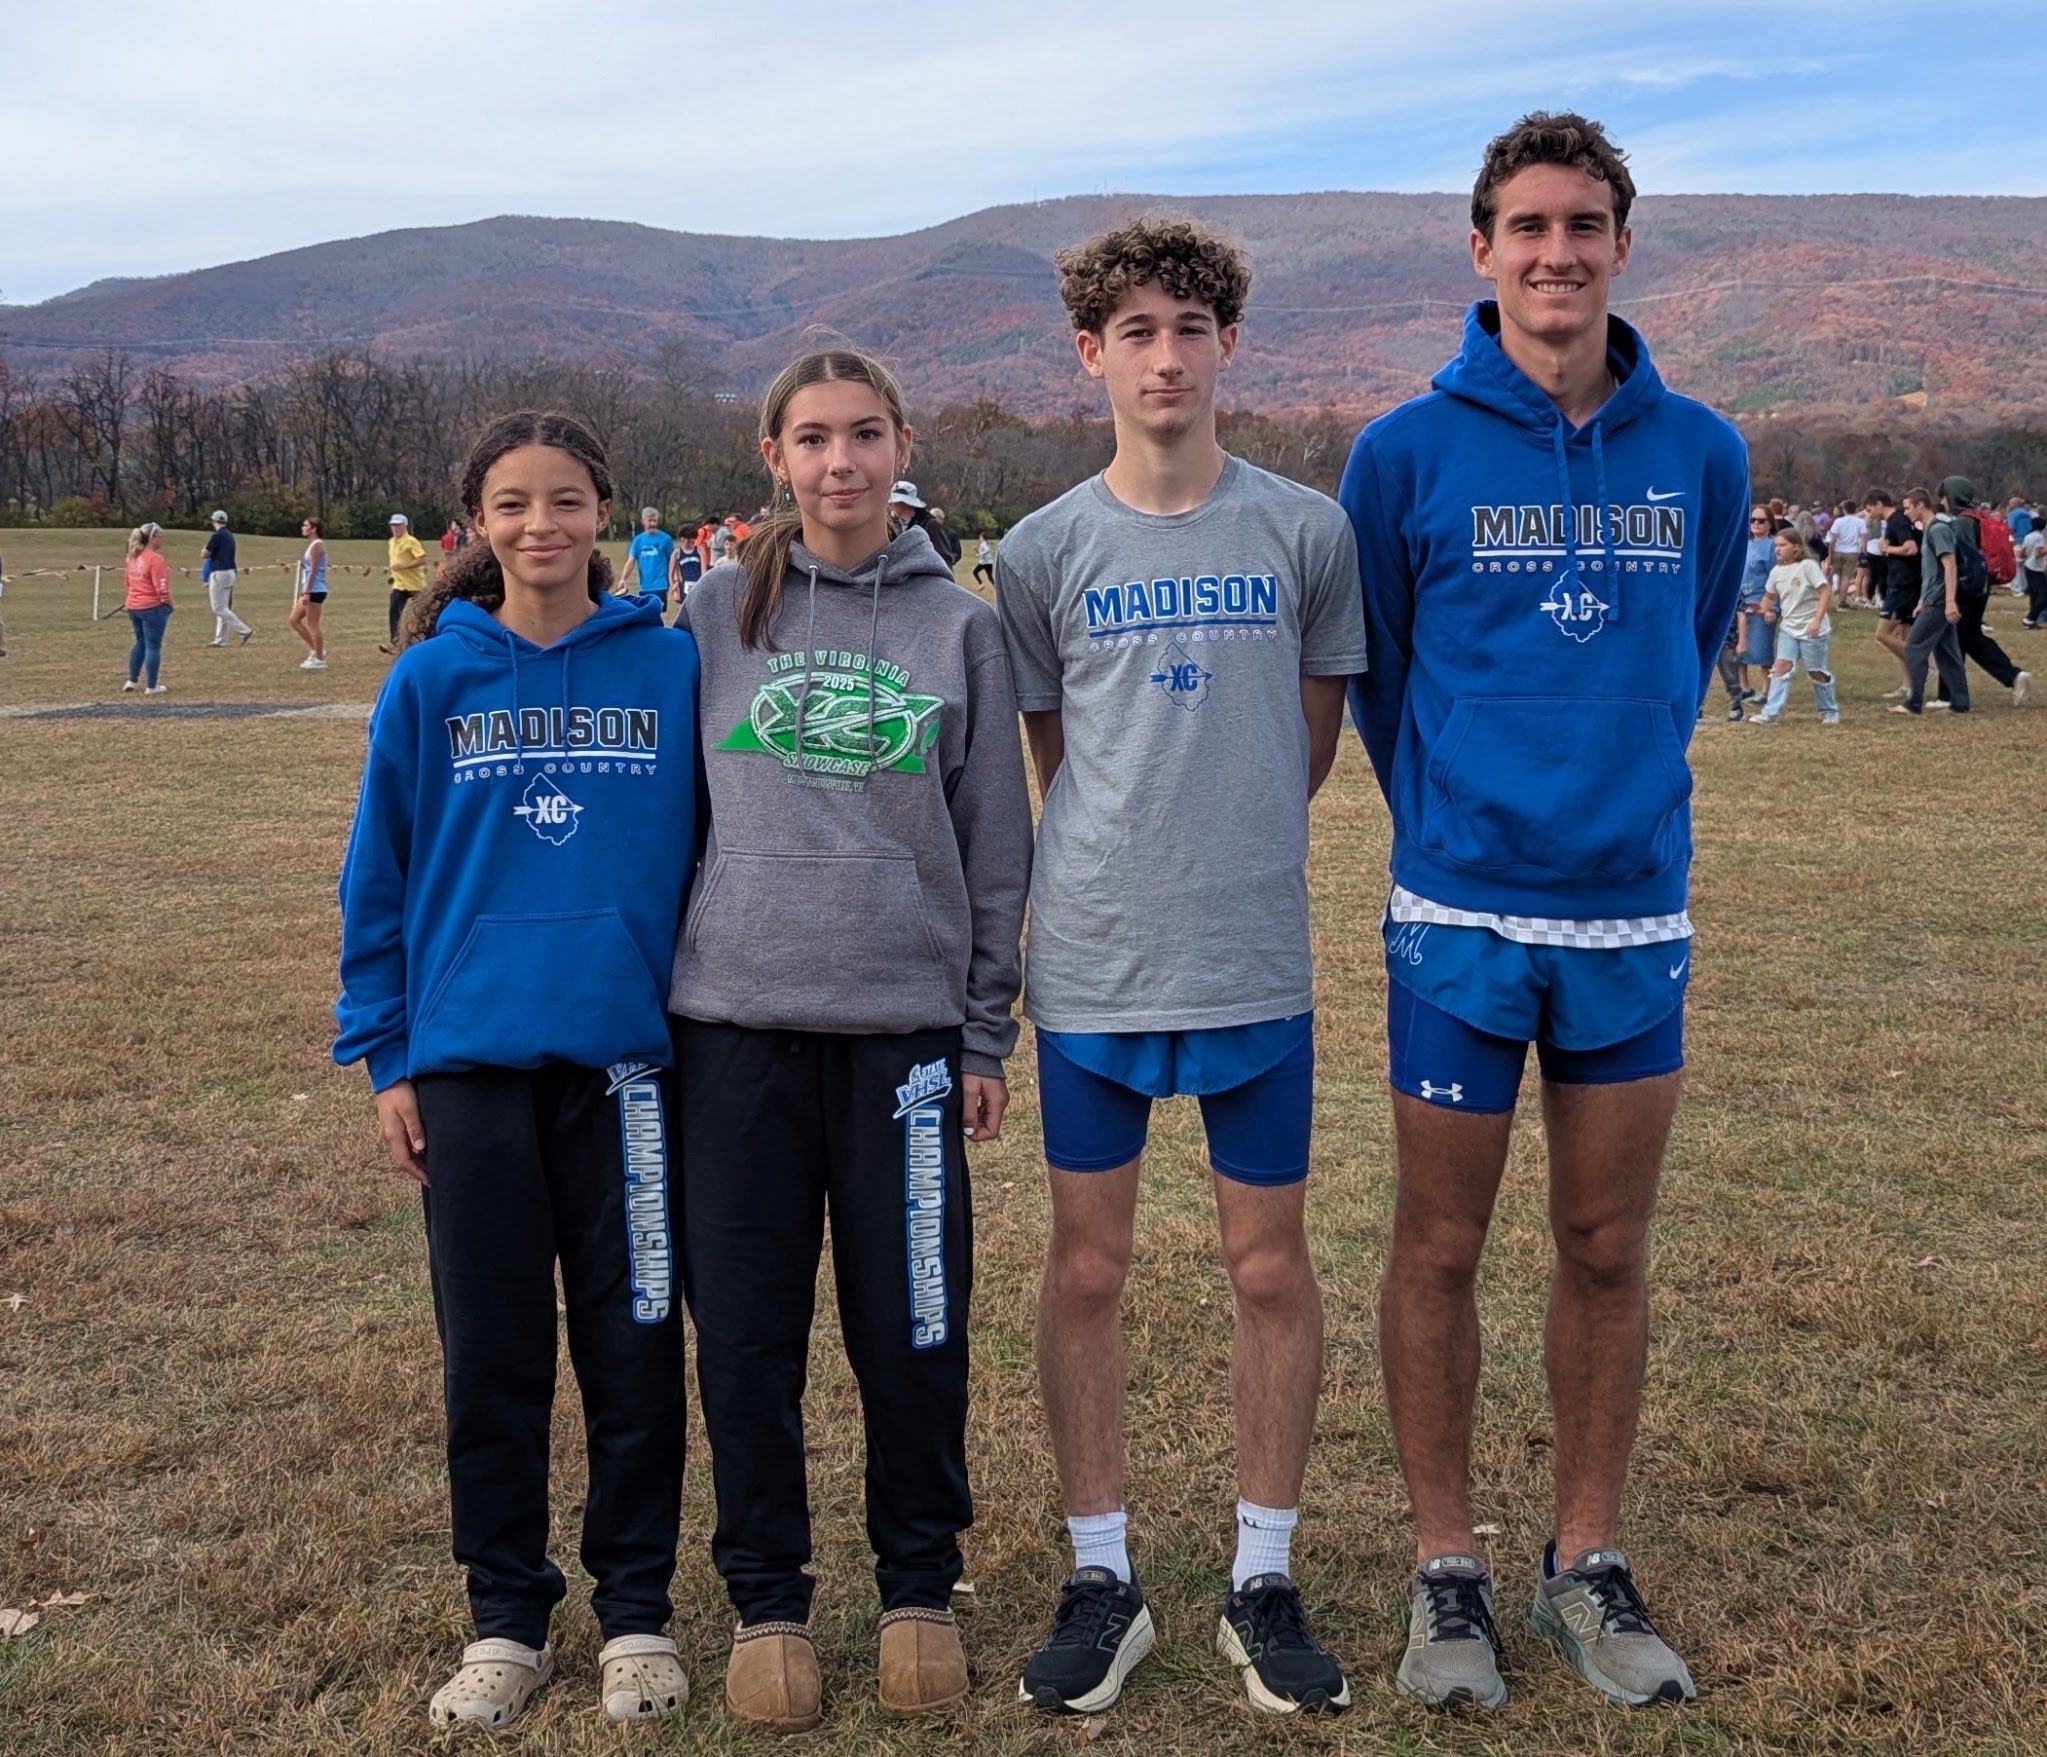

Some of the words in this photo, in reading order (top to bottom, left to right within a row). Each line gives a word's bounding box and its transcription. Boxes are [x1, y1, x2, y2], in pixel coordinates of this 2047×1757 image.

[1471, 504, 1685, 549] MADISON
[1472, 560, 1553, 573] CROSS
[1083, 575, 1278, 629] MADISON
[1089, 633, 1158, 652] CROSS
[1175, 629, 1278, 643] COUNTRY
[767, 651, 805, 674] THE
[823, 675, 856, 692] 2025
[1169, 663, 1198, 692] XC
[445, 707, 658, 759] MADISON
[454, 764, 524, 784] CROSS
[544, 762, 656, 776] COUNTRY
[535, 795, 567, 824] XC
[921, 1057, 947, 1077] STATE
[895, 1069, 951, 1107] VHSL
[622, 1083, 671, 1321] CHAMPIONSHIPS
[908, 1108, 947, 1347] CHAMPIONSHIPS
